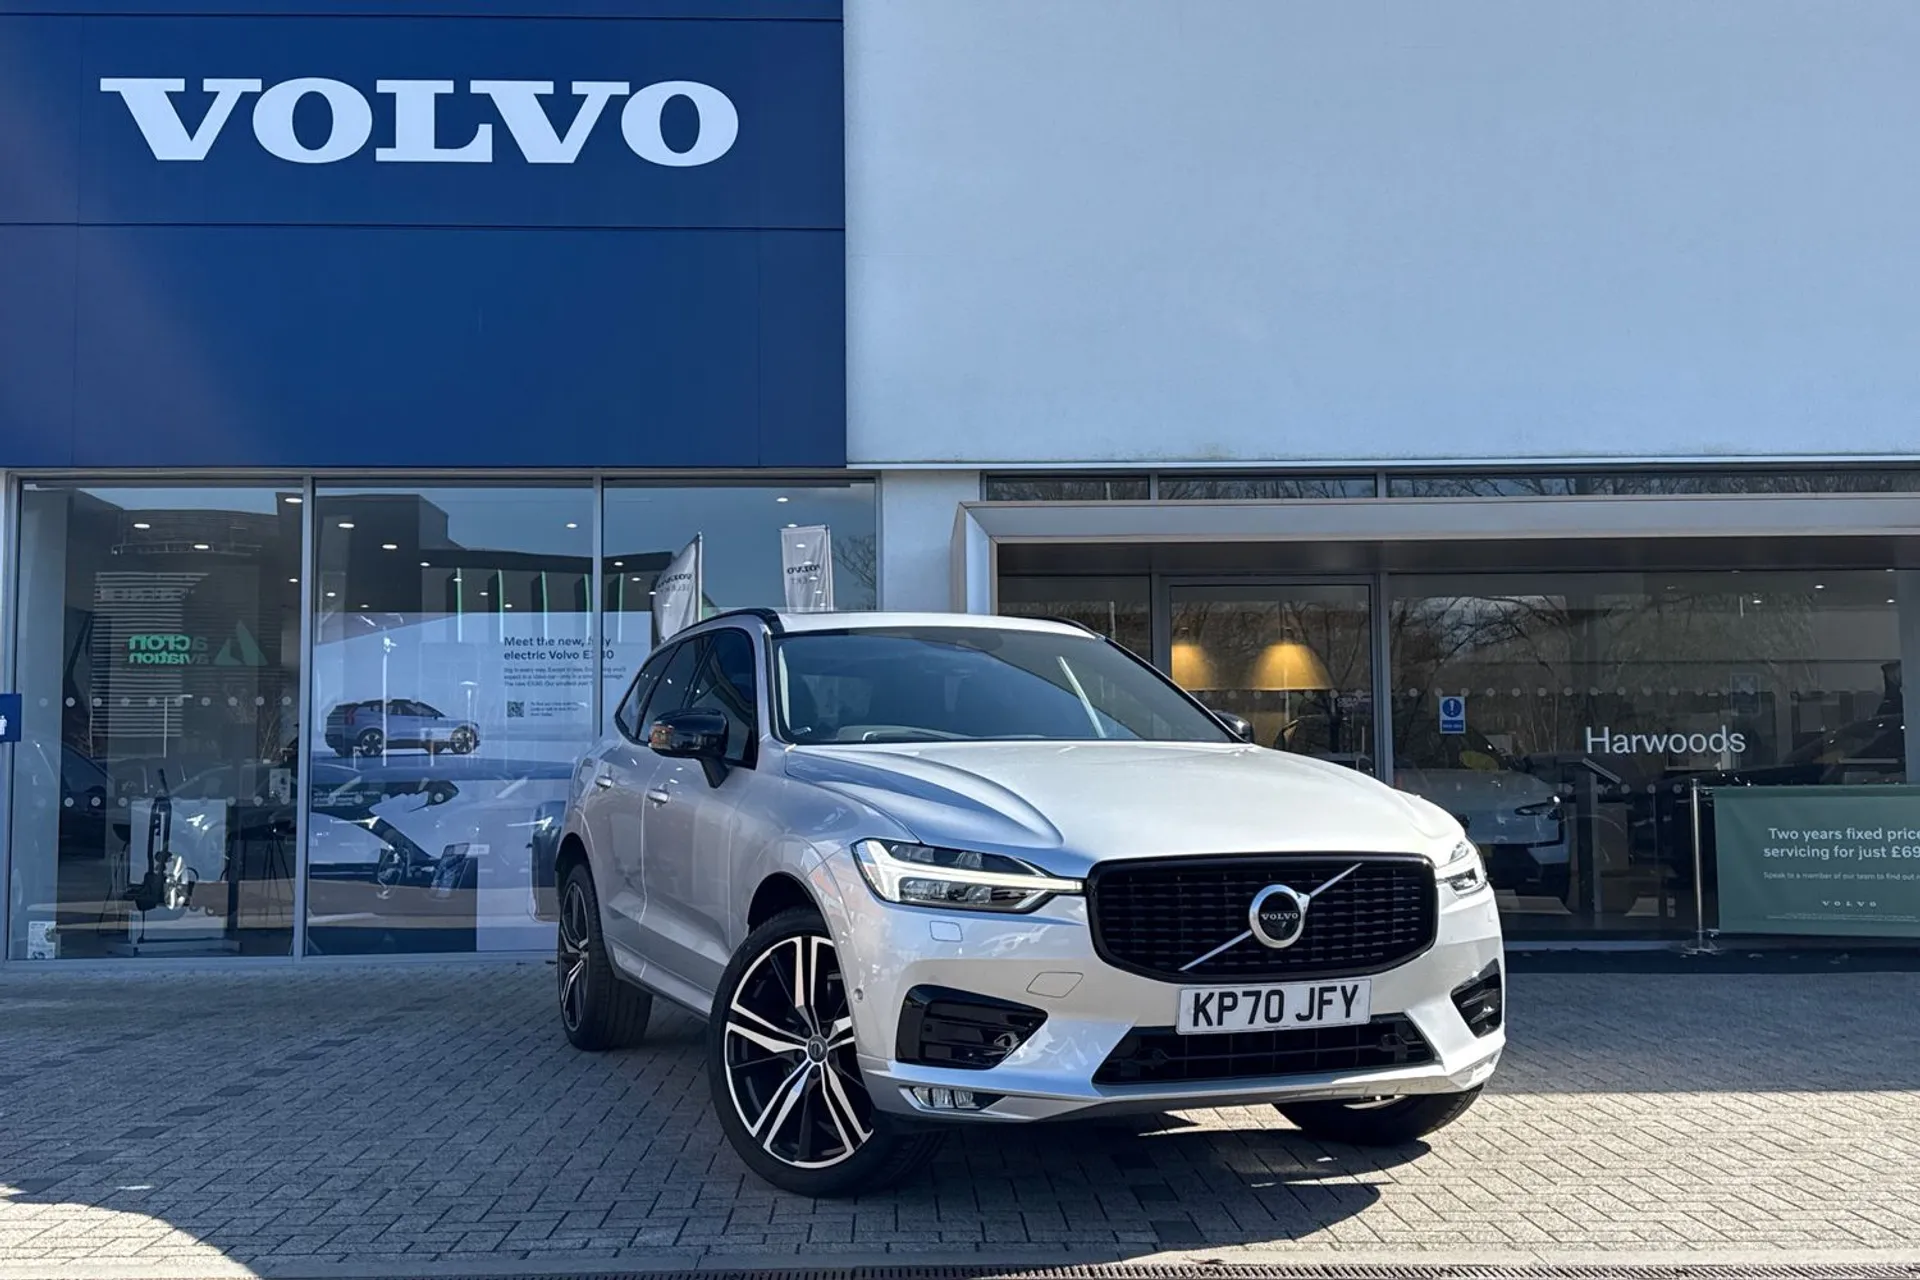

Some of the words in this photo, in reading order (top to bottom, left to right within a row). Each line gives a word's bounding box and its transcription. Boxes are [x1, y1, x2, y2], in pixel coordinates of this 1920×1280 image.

[100, 77, 740, 167] VOLVO
[504, 636, 533, 647] Meet
[536, 636, 555, 647] the
[557, 637, 585, 648] new,
[503, 650, 547, 661] electric
[548, 649, 580, 660] Volvo
[582, 650, 616, 660] E0
[1585, 725, 1746, 754] Harwoods
[1768, 827, 1799, 840] Two
[1802, 830, 1842, 842] years
[1846, 827, 1882, 840] fixed
[1763, 845, 1830, 860] servicing
[1833, 845, 1854, 858] for
[1857, 845, 1887, 861] just
[1821, 900, 1877, 908] VOLVO
[1260, 912, 1299, 921] VOLVO
[1191, 988, 1285, 1028] KP70
[1295, 984, 1360, 1023] JFY
